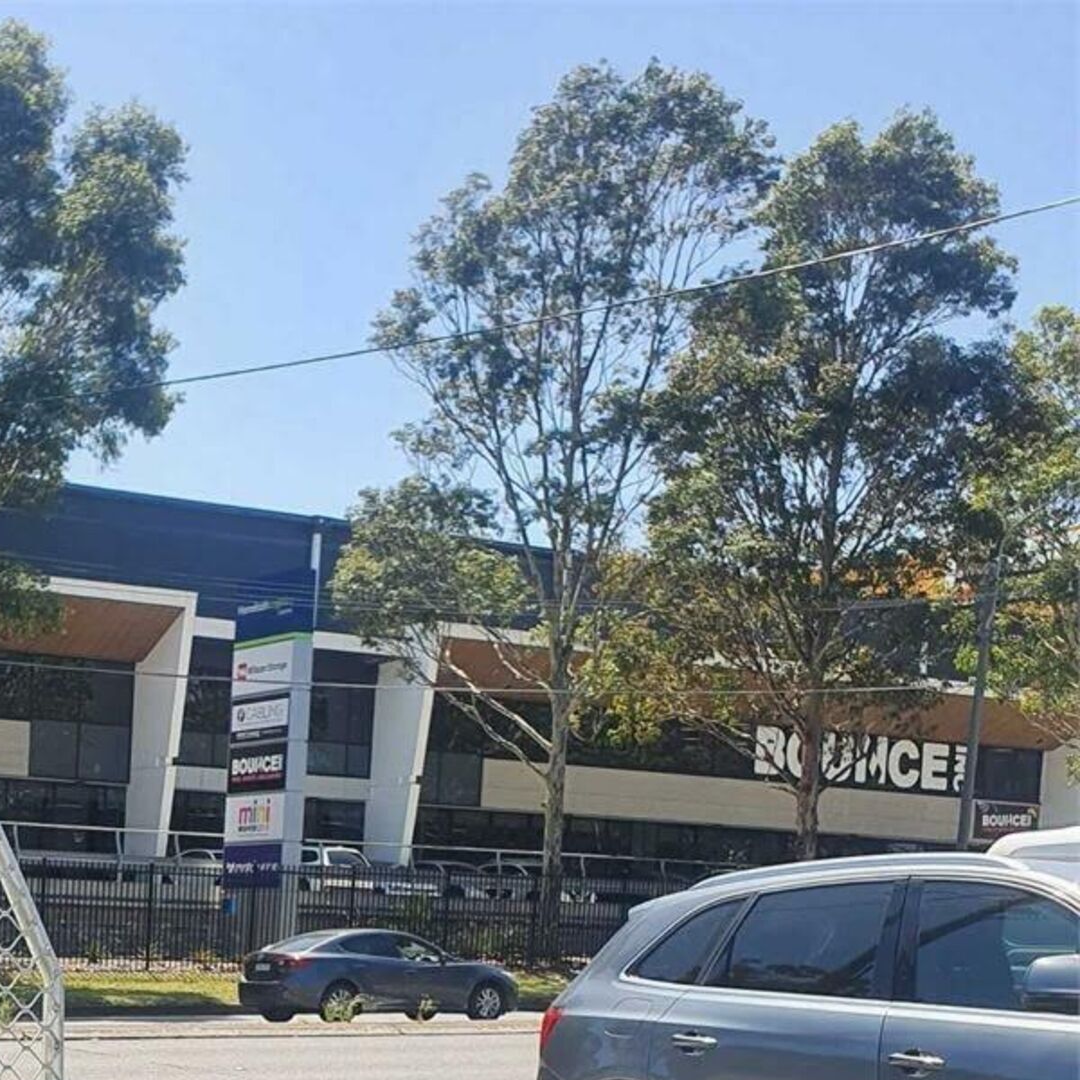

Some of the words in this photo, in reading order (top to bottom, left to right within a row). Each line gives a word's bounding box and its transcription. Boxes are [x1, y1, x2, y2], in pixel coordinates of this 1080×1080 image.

[232, 754, 280, 775] BOUNCE
[239, 798, 271, 825] mini
[982, 814, 1027, 827] BOUNCE
